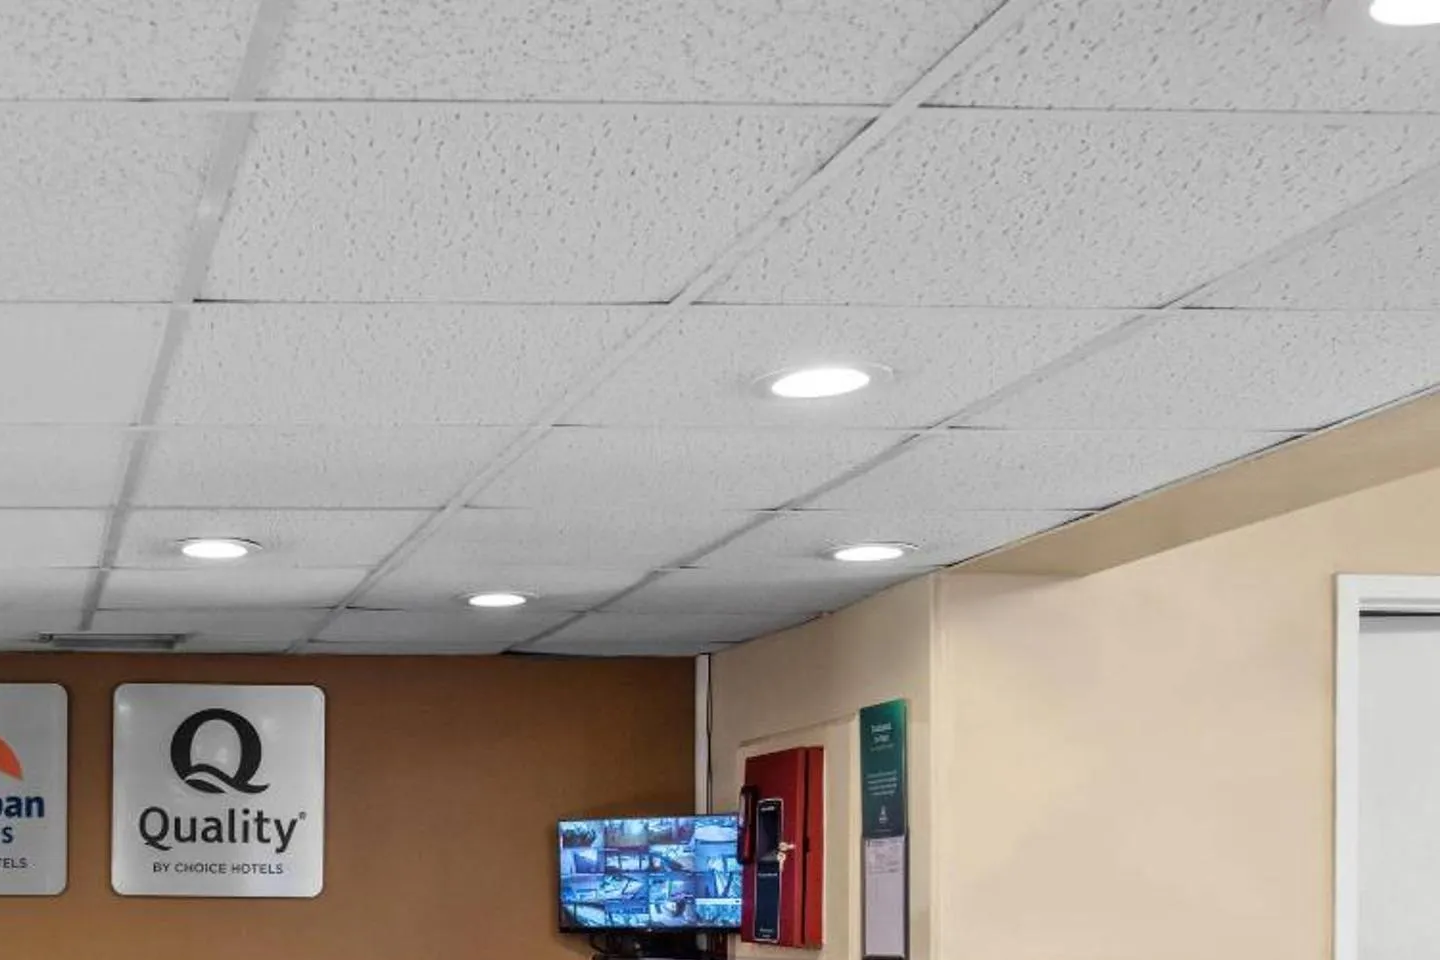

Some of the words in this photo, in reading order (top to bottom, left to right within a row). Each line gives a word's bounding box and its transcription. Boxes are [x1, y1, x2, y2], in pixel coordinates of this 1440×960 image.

[170, 708, 270, 794] Q
[153, 861, 170, 874] BY
[174, 862, 226, 874] CHOICE
[231, 863, 284, 875] HOTELS
